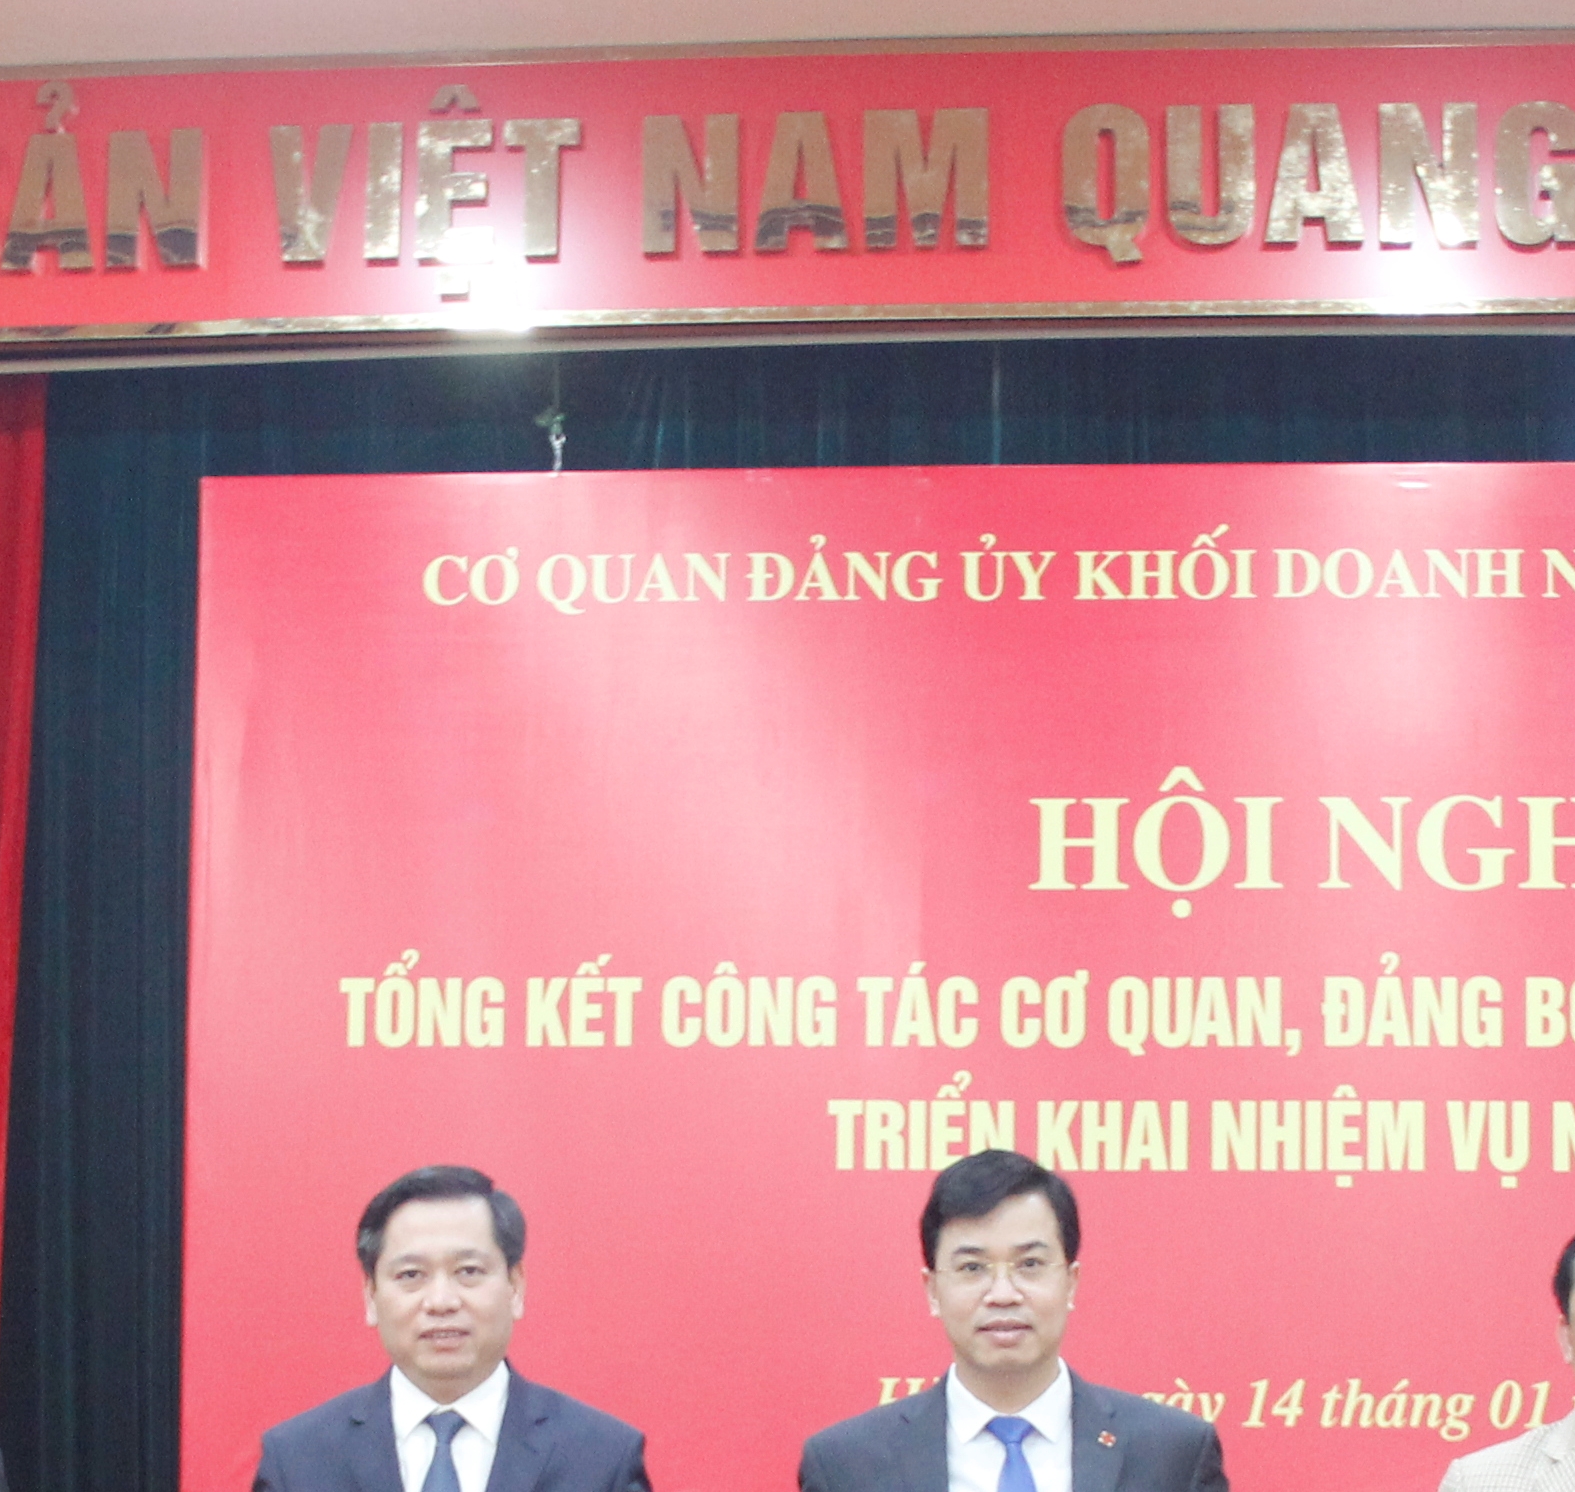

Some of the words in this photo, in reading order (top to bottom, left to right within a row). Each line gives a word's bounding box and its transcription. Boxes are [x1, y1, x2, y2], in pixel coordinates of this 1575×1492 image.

[267, 84, 580, 296] VIỆT
[640, 107, 990, 254] NAM
[423, 546, 520, 606] CƠ
[536, 552, 730, 615] QUAN
[746, 534, 943, 603] ĐẢNG
[960, 533, 1057, 603] ỦY
[1074, 524, 1258, 602] KHỐI
[1272, 547, 1524, 600] DOANH
[1029, 765, 1284, 919] HỘI
[340, 949, 505, 1048] TỔNG
[526, 953, 642, 1048] KẾT
[660, 961, 837, 1049] CÔNG
[857, 957, 978, 1049] TÁC
[1000, 968, 1090, 1049] CƠ
[1107, 974, 1301, 1057] QUAN,
[1321, 952, 1503, 1049] ĐẢNG
[828, 1070, 1015, 1172] TRIỂN
[1035, 1100, 1188, 1172] KHAI
[1210, 1084, 1424, 1188] NHIỆM
[1447, 1100, 1529, 1188] VỤ
[1242, 1378, 1306, 1428] 14
[1320, 1378, 1476, 1442] tháng
[1489, 1380, 1551, 1430] 01
